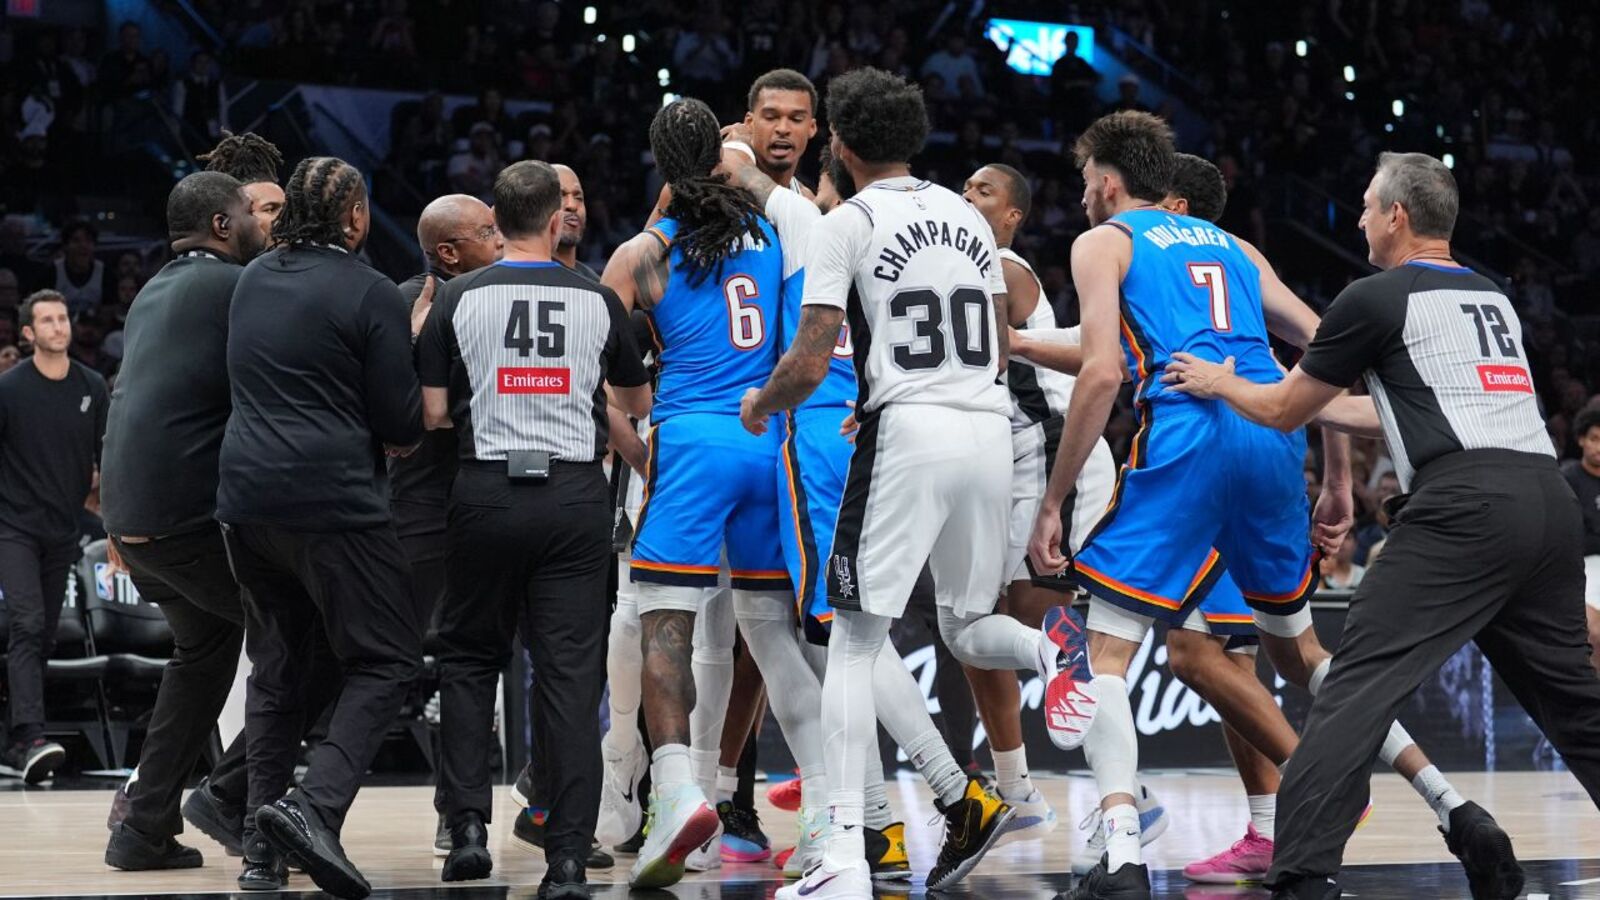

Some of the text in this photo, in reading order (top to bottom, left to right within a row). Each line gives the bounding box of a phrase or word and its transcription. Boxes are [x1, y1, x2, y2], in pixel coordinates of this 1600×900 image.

[874, 220, 991, 283] CHAMPAGNIE
[504, 300, 565, 358] 45
[723, 273, 765, 351] 6
[887, 284, 993, 373] 30
[1186, 262, 1231, 333] 7
[1460, 304, 1519, 358] 72
[503, 373, 564, 388] Emirates
